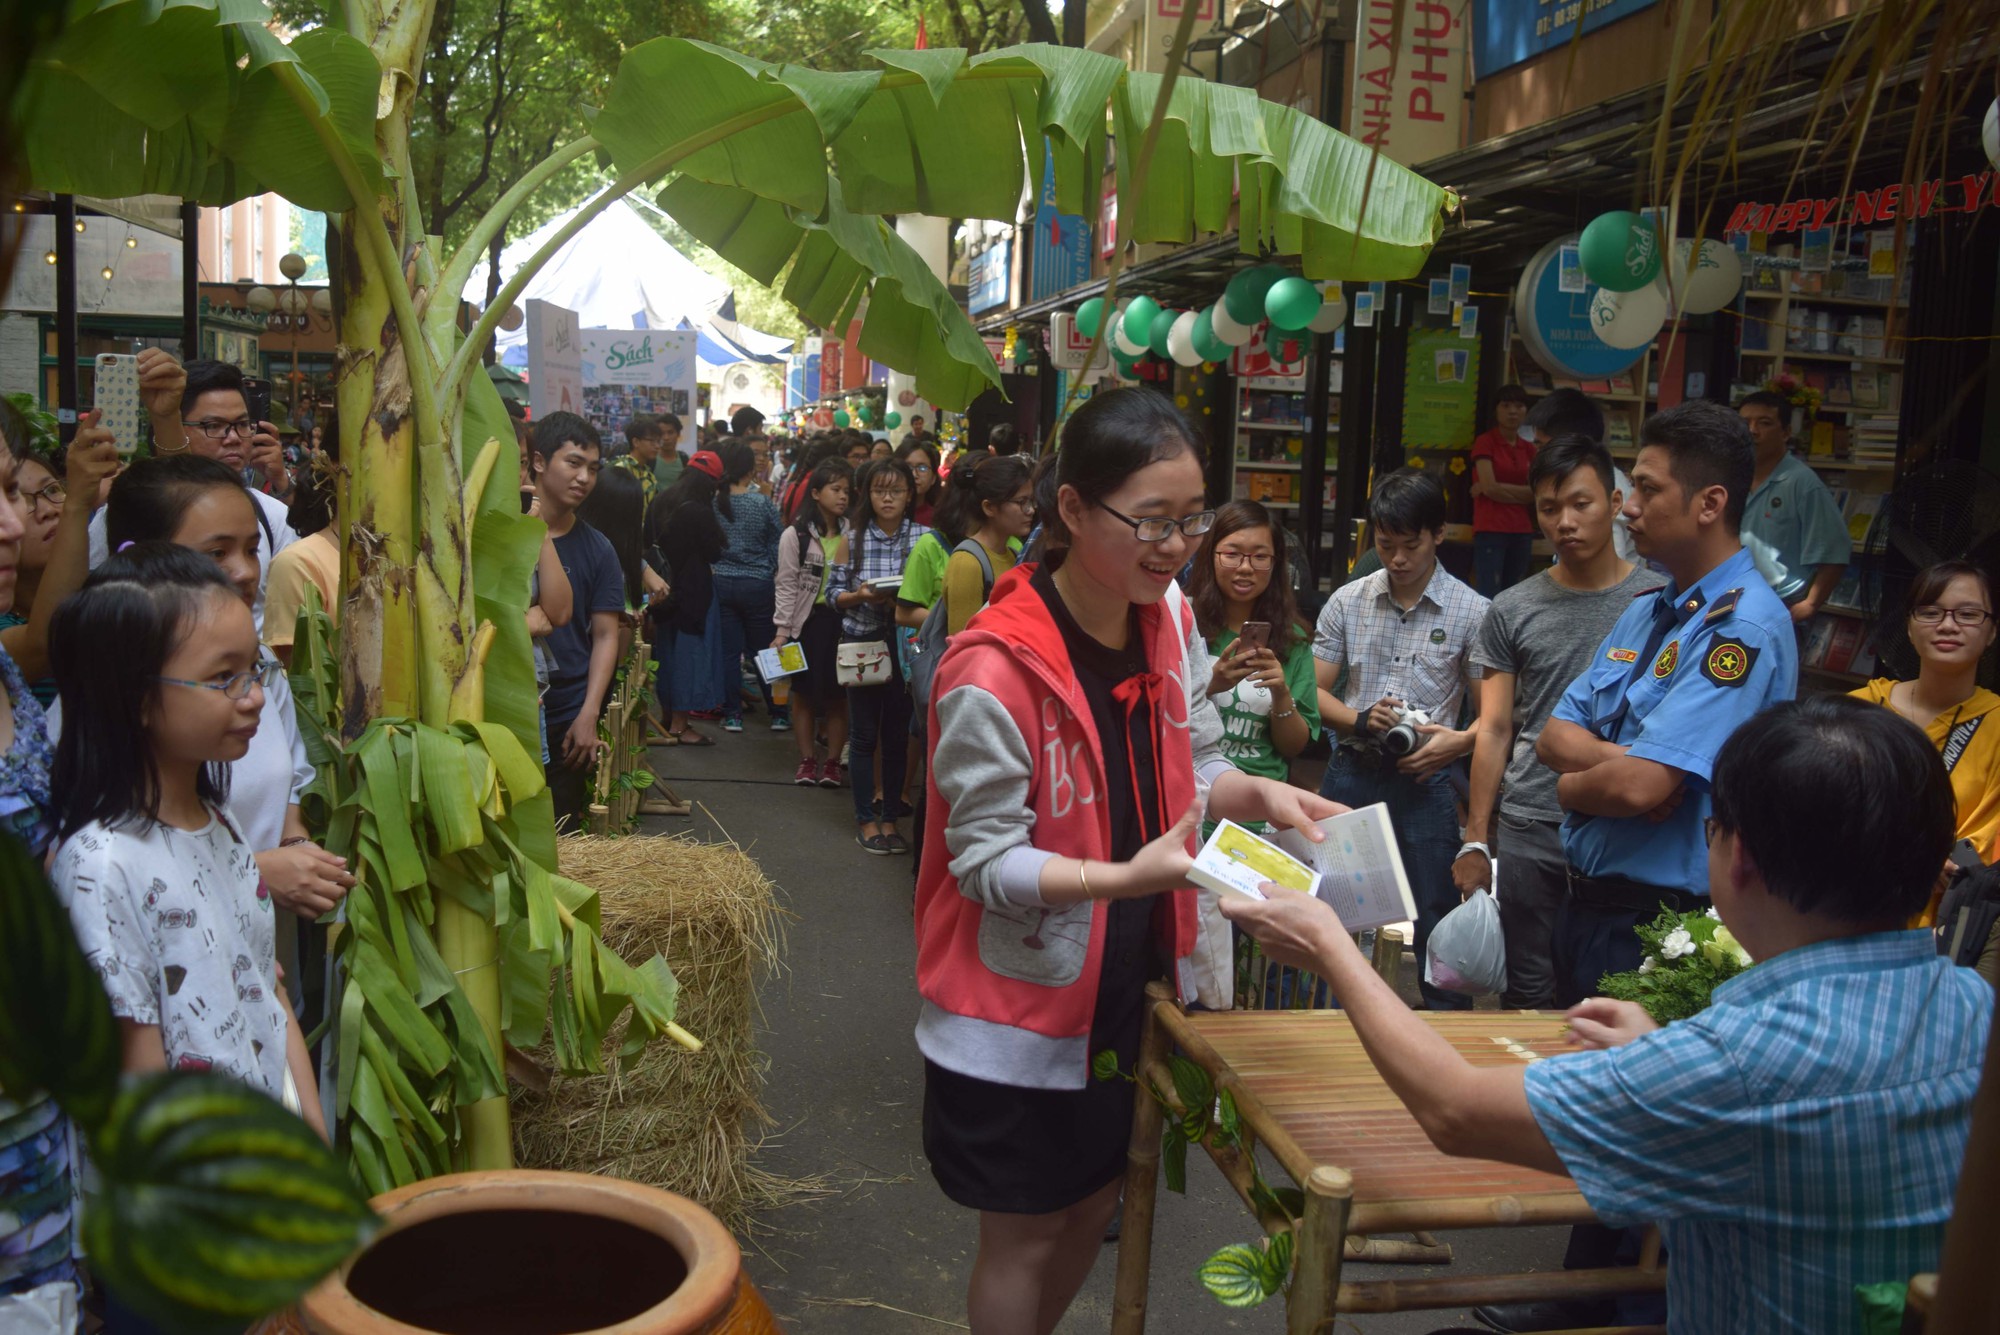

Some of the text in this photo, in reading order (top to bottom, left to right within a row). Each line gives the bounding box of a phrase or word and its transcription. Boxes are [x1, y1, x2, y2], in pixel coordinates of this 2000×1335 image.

[1725, 197, 1838, 234] HAPPY
[605, 335, 654, 370] Sách
[1220, 738, 1261, 759] BOSS
